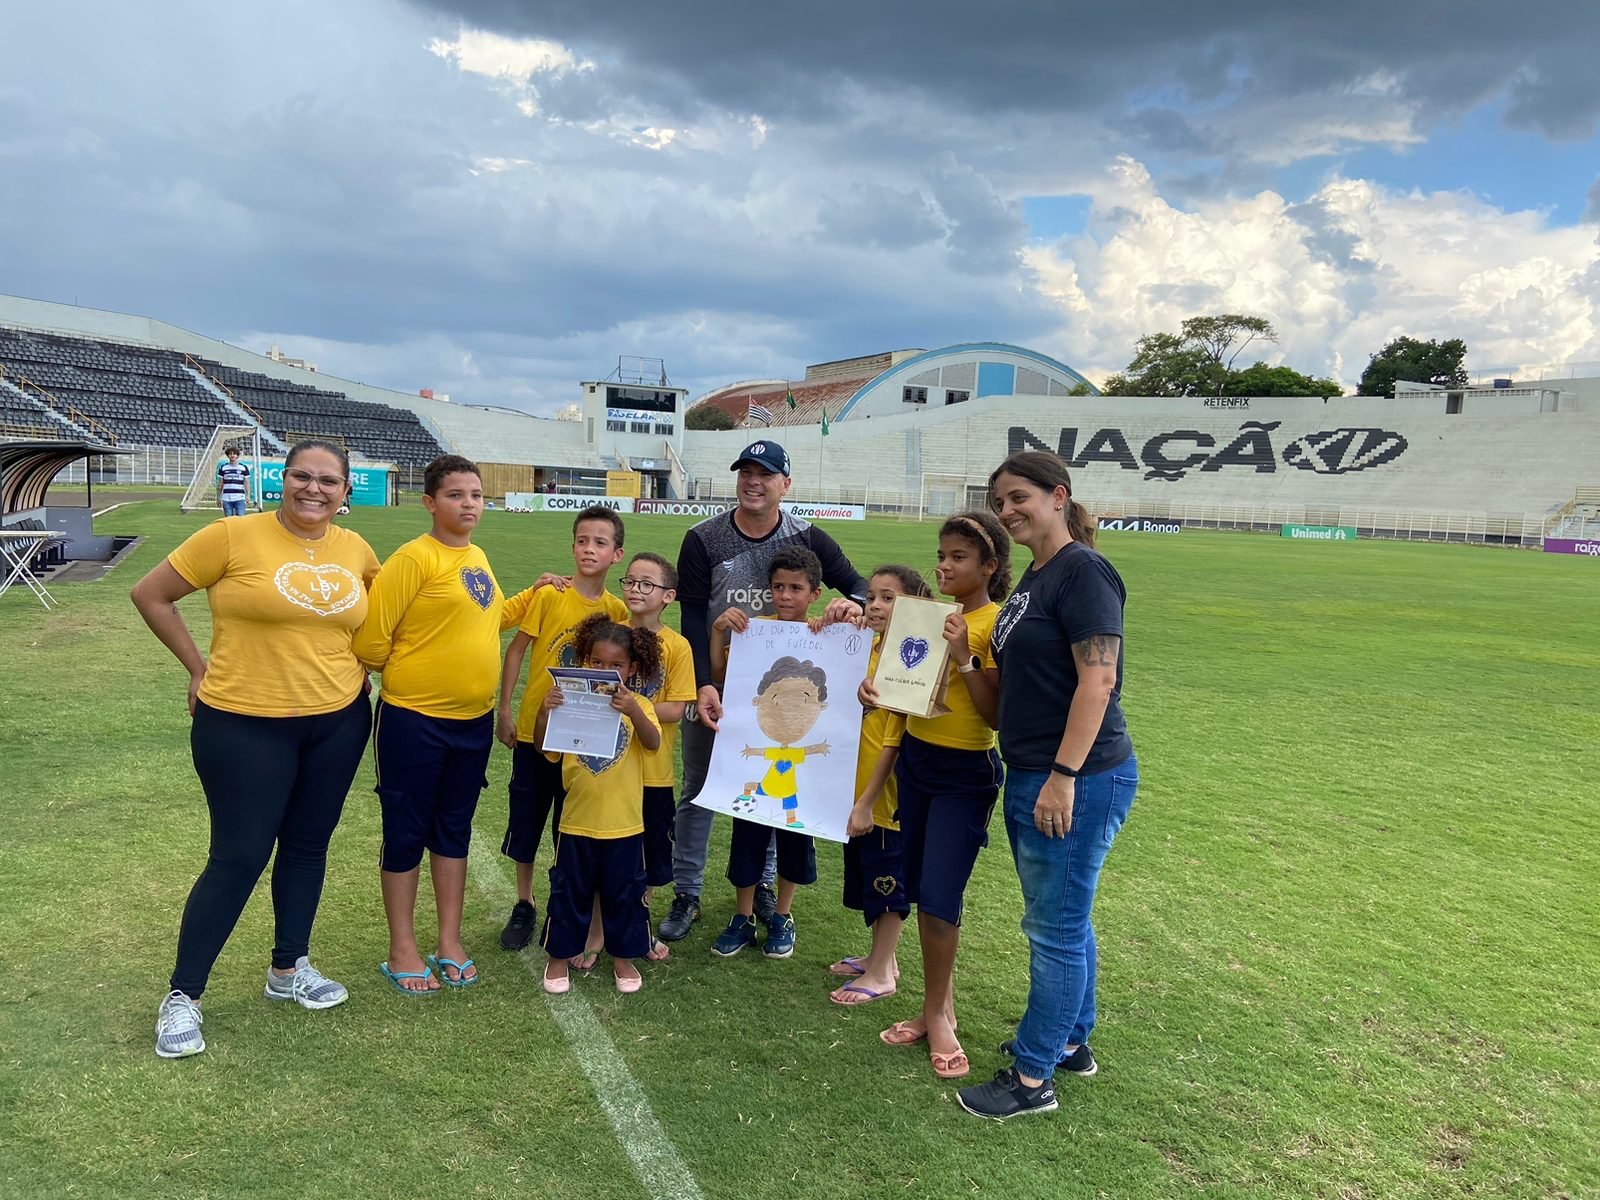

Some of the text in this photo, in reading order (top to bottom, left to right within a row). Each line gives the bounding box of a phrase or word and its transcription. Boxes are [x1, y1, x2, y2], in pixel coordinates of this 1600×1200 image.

[1203, 397, 1250, 407] RETENFIX
[652, 502, 726, 517] UNIODONTO
[1291, 526, 1332, 540] Unimed
[726, 584, 774, 611] raíze
